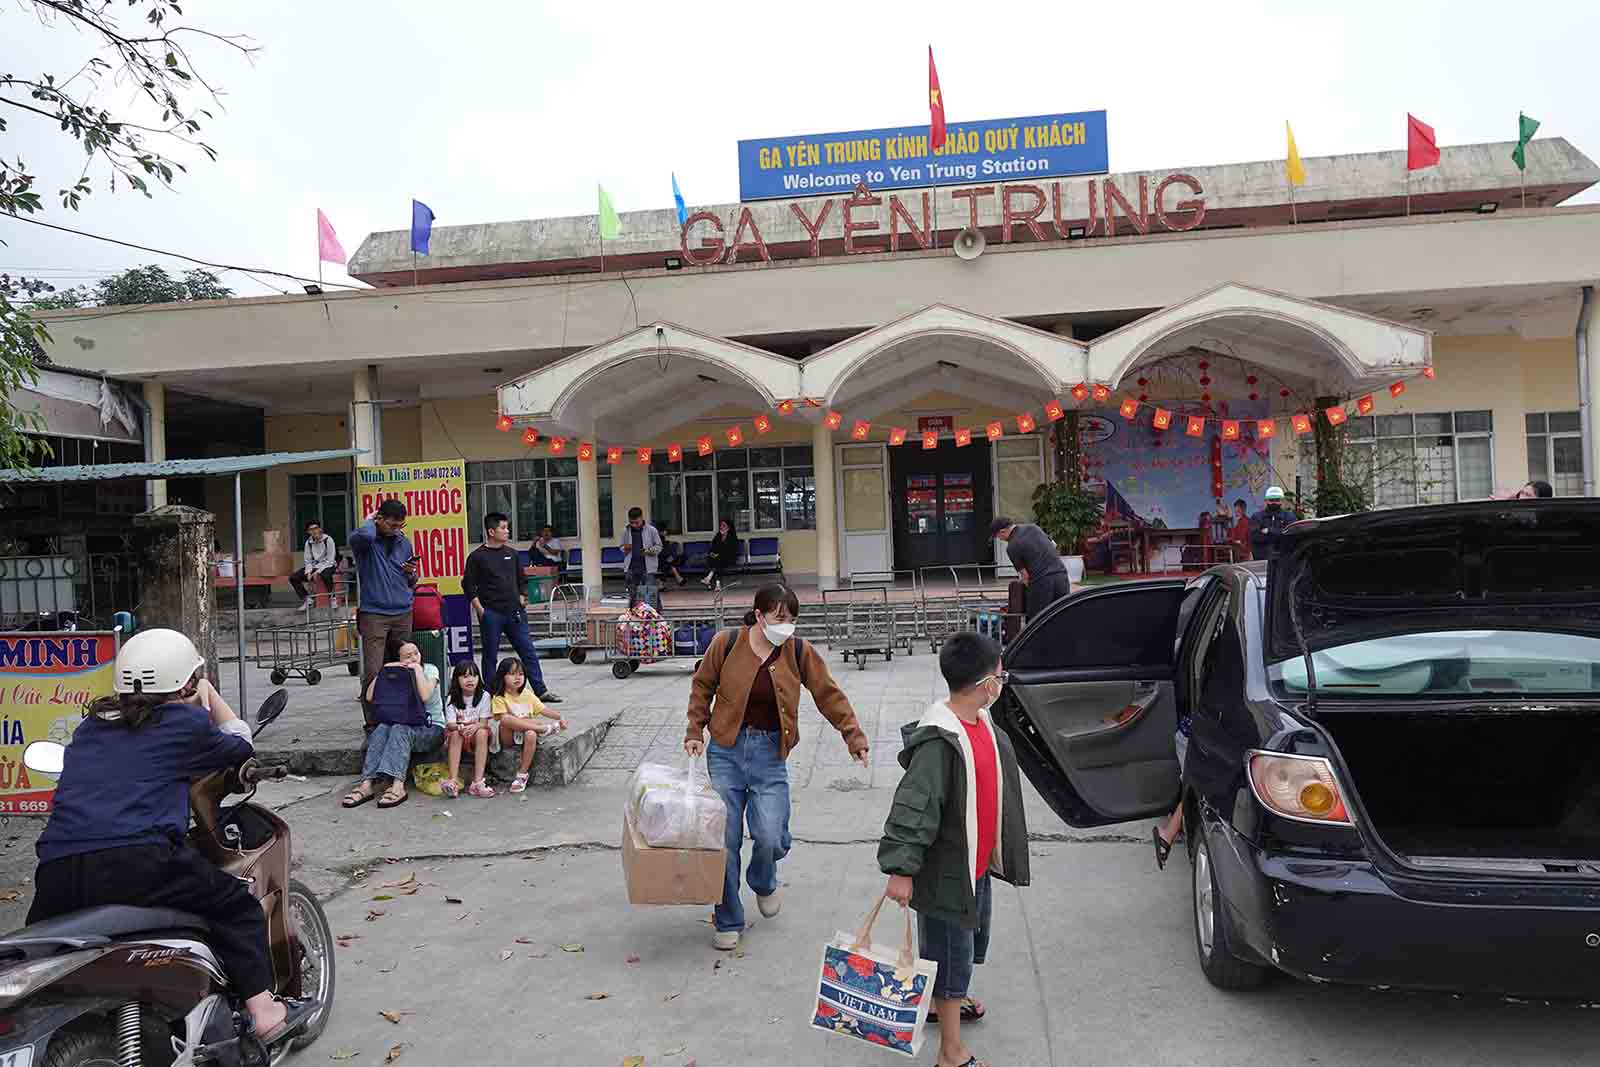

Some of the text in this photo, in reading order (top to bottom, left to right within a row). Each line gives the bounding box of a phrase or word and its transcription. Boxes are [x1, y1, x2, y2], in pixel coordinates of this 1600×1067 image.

[759, 148, 782, 169] GA
[787, 140, 820, 167] YÊN
[825, 138, 880, 165] TRUNG
[886, 133, 927, 161] KÍNH
[985, 123, 1018, 153] QUÝ
[1024, 120, 1086, 148] KHÁCH
[784, 156, 1049, 189] Welcome to Yen Trung Station
[680, 174, 1206, 265] GA YÊN TRUNG
[360, 470, 384, 482] Minh
[404, 480, 462, 516] THUỐC
[0, 639, 98, 667] MINH
[0, 715, 24, 745] ÍA
[19, 800, 48, 812] 669
[838, 992, 897, 1021] VIET NAM
